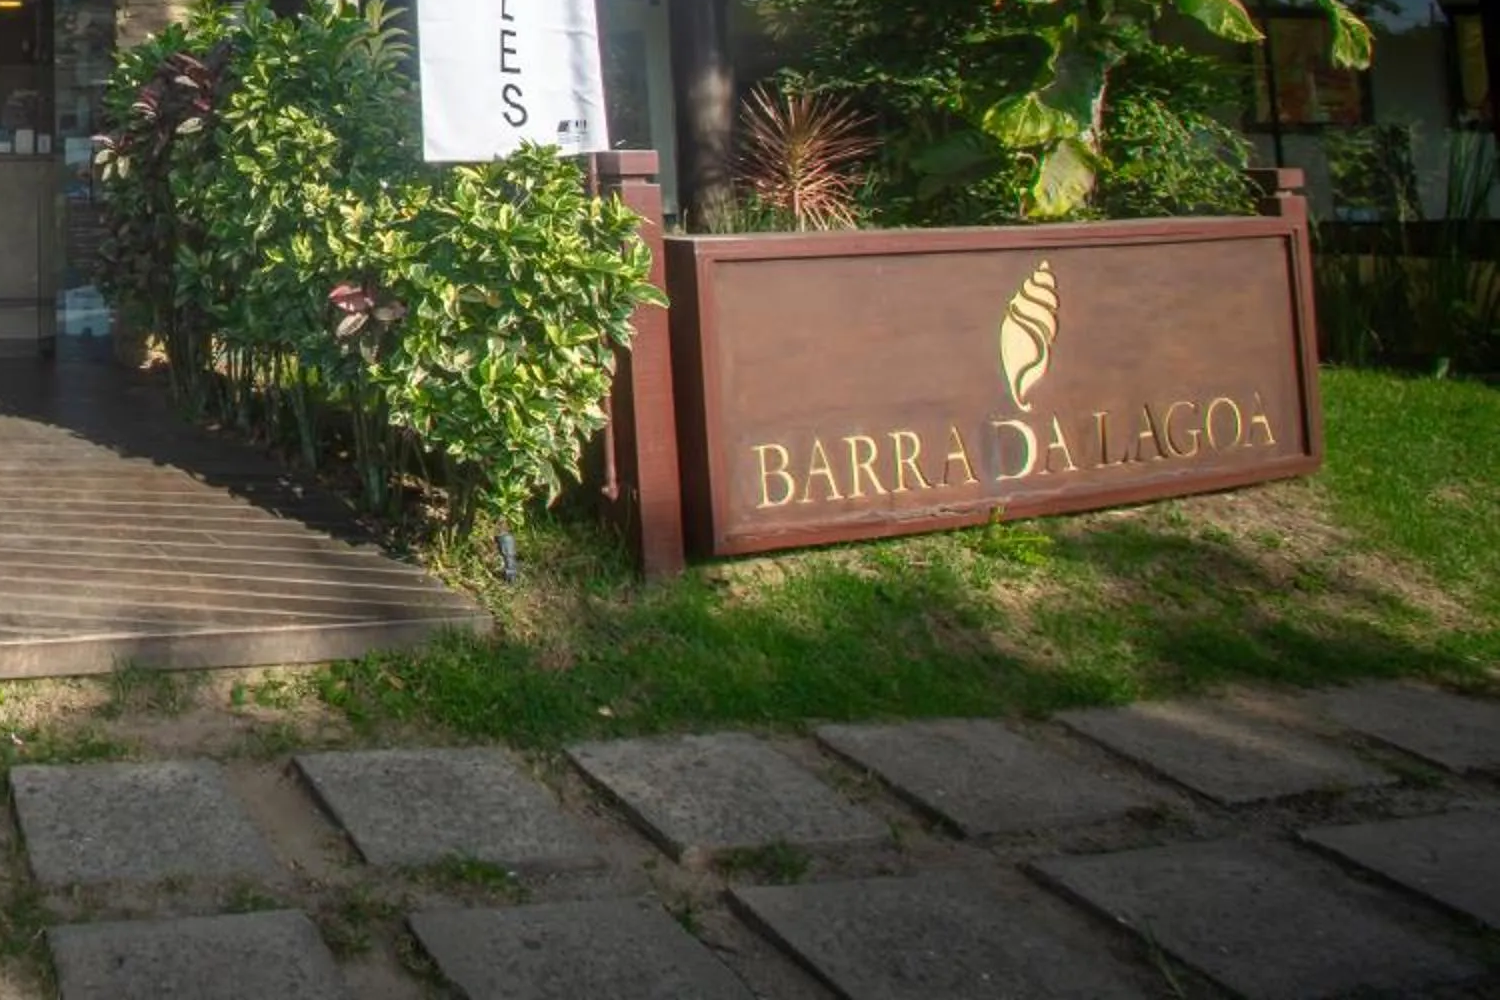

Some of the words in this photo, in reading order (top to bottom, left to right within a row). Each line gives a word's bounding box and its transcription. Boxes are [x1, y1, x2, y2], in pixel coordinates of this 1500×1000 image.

[751, 425, 981, 509] BARRA
[990, 411, 1078, 481] DA
[1092, 391, 1277, 469] LAGOA
